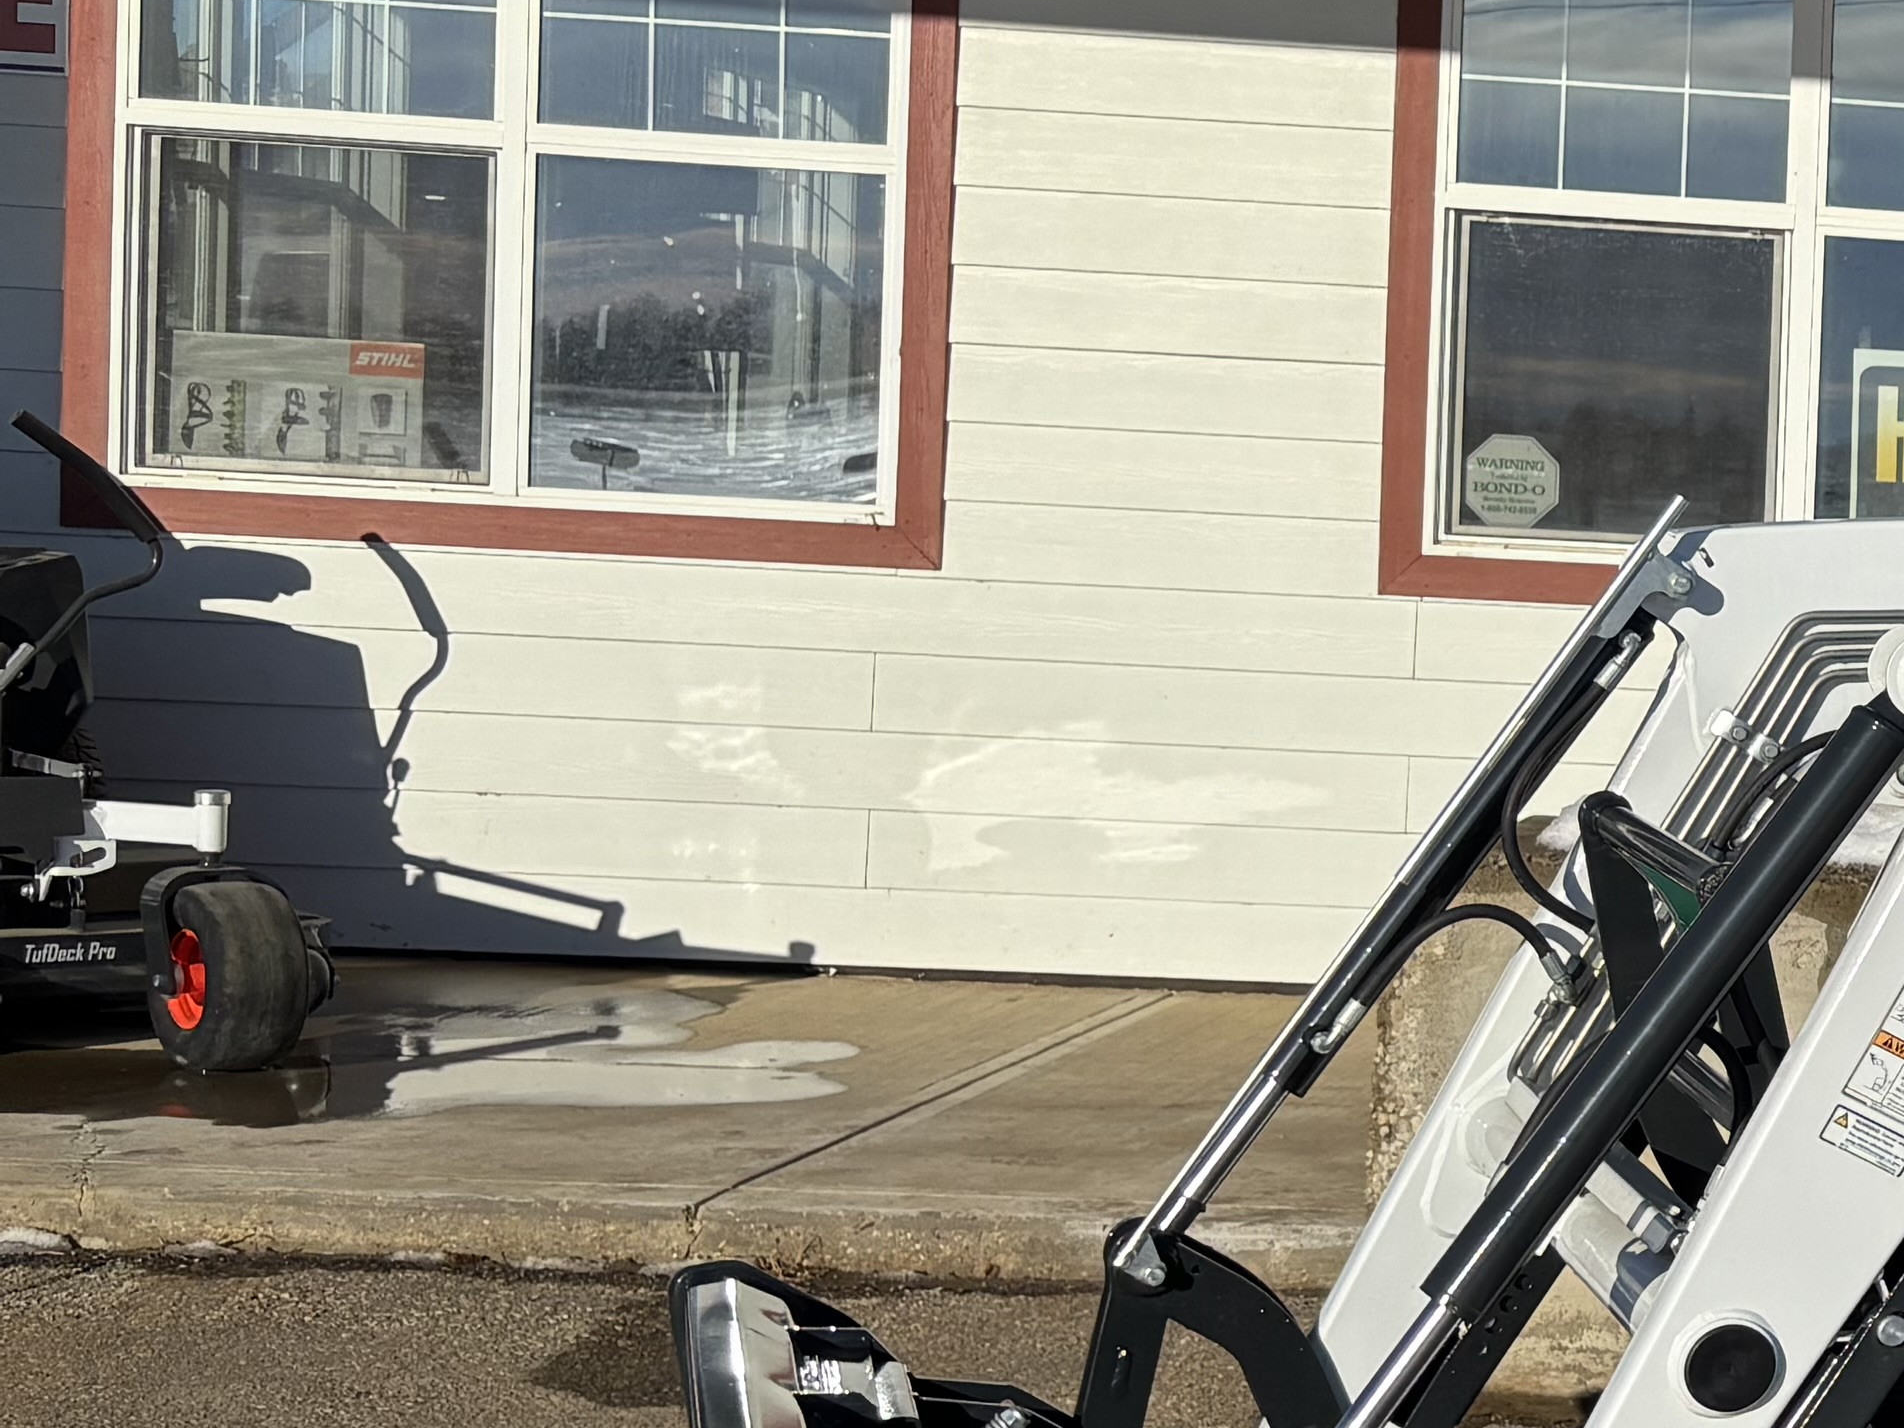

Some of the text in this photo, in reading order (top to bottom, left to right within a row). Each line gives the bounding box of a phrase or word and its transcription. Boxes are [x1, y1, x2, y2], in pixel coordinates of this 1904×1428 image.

[355, 351, 416, 369] STIHL
[1476, 457, 1545, 472] WARNING
[25, 941, 117, 964] TufDeck Pro
